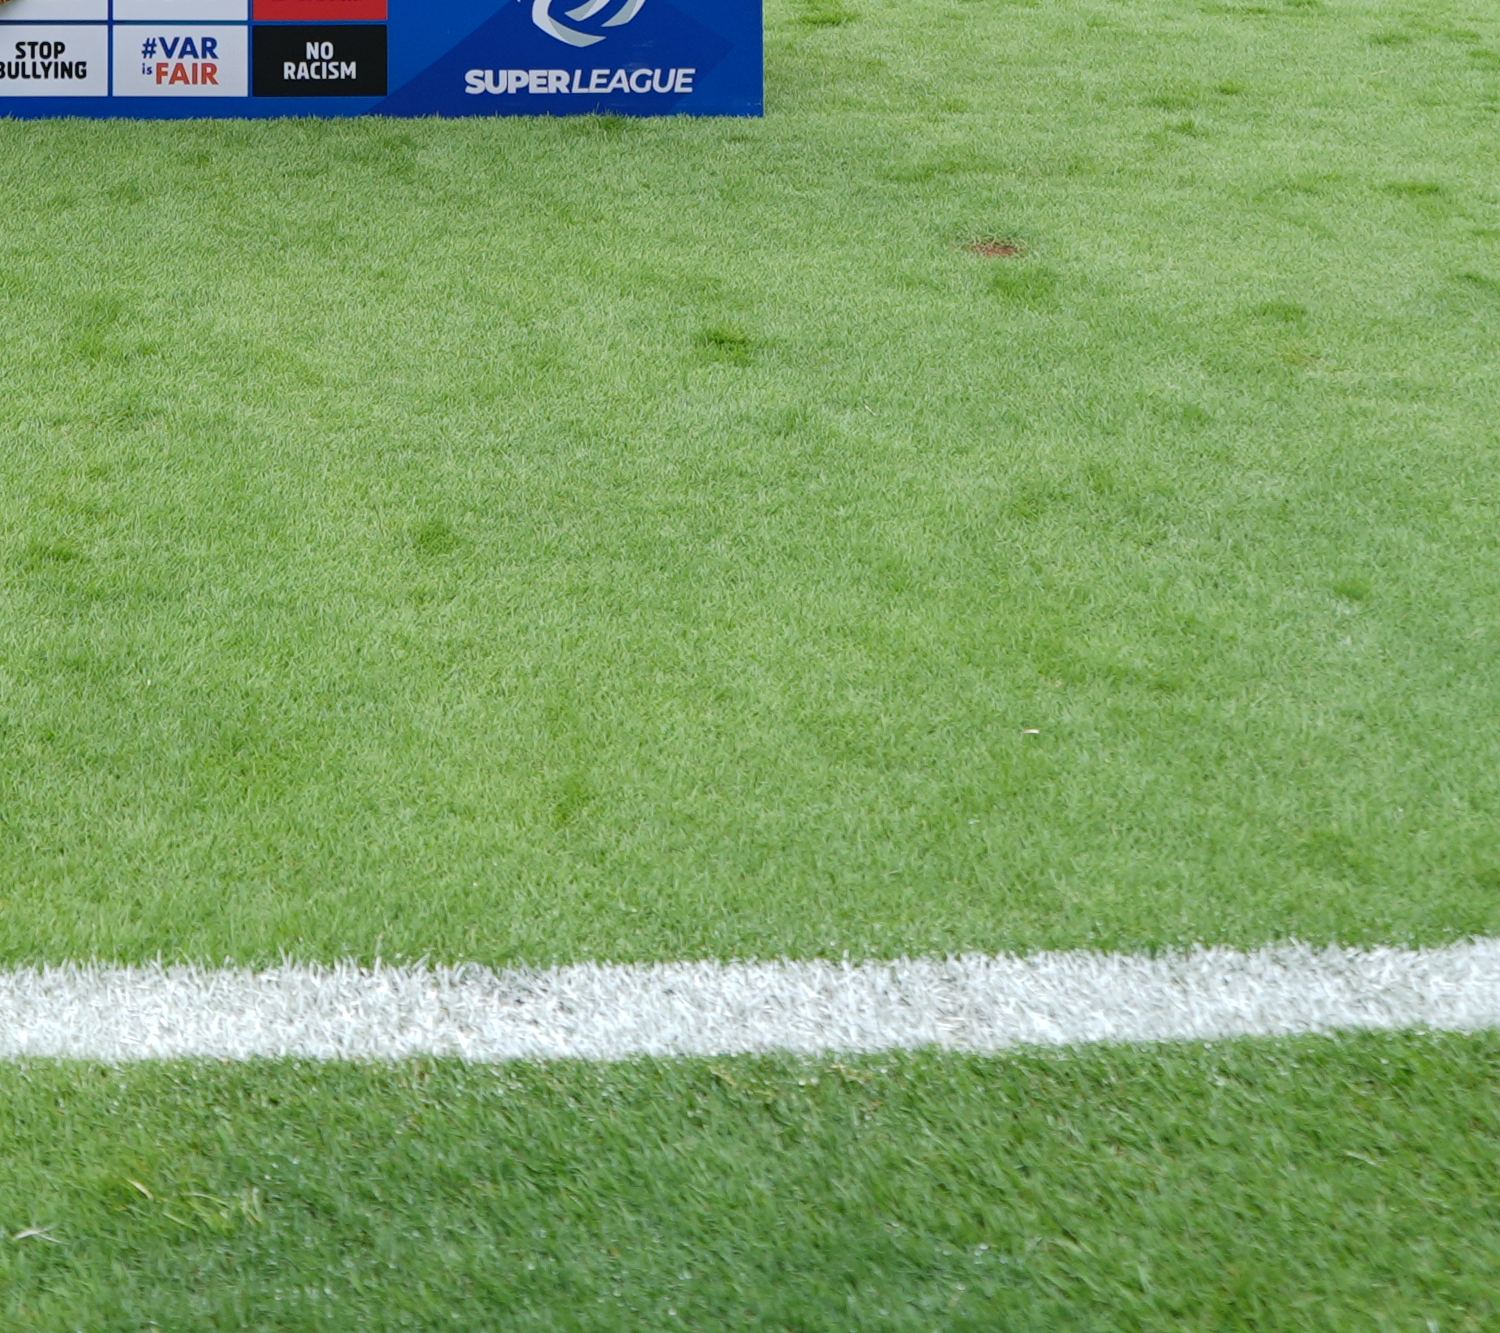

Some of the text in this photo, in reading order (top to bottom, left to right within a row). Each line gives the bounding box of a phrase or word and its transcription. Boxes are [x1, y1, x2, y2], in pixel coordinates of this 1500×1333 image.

[15, 41, 66, 60] STOP
[142, 36, 219, 60] #VAR
[306, 41, 334, 61] NO
[142, 62, 219, 86] is FAIR
[283, 61, 357, 81] RACISM
